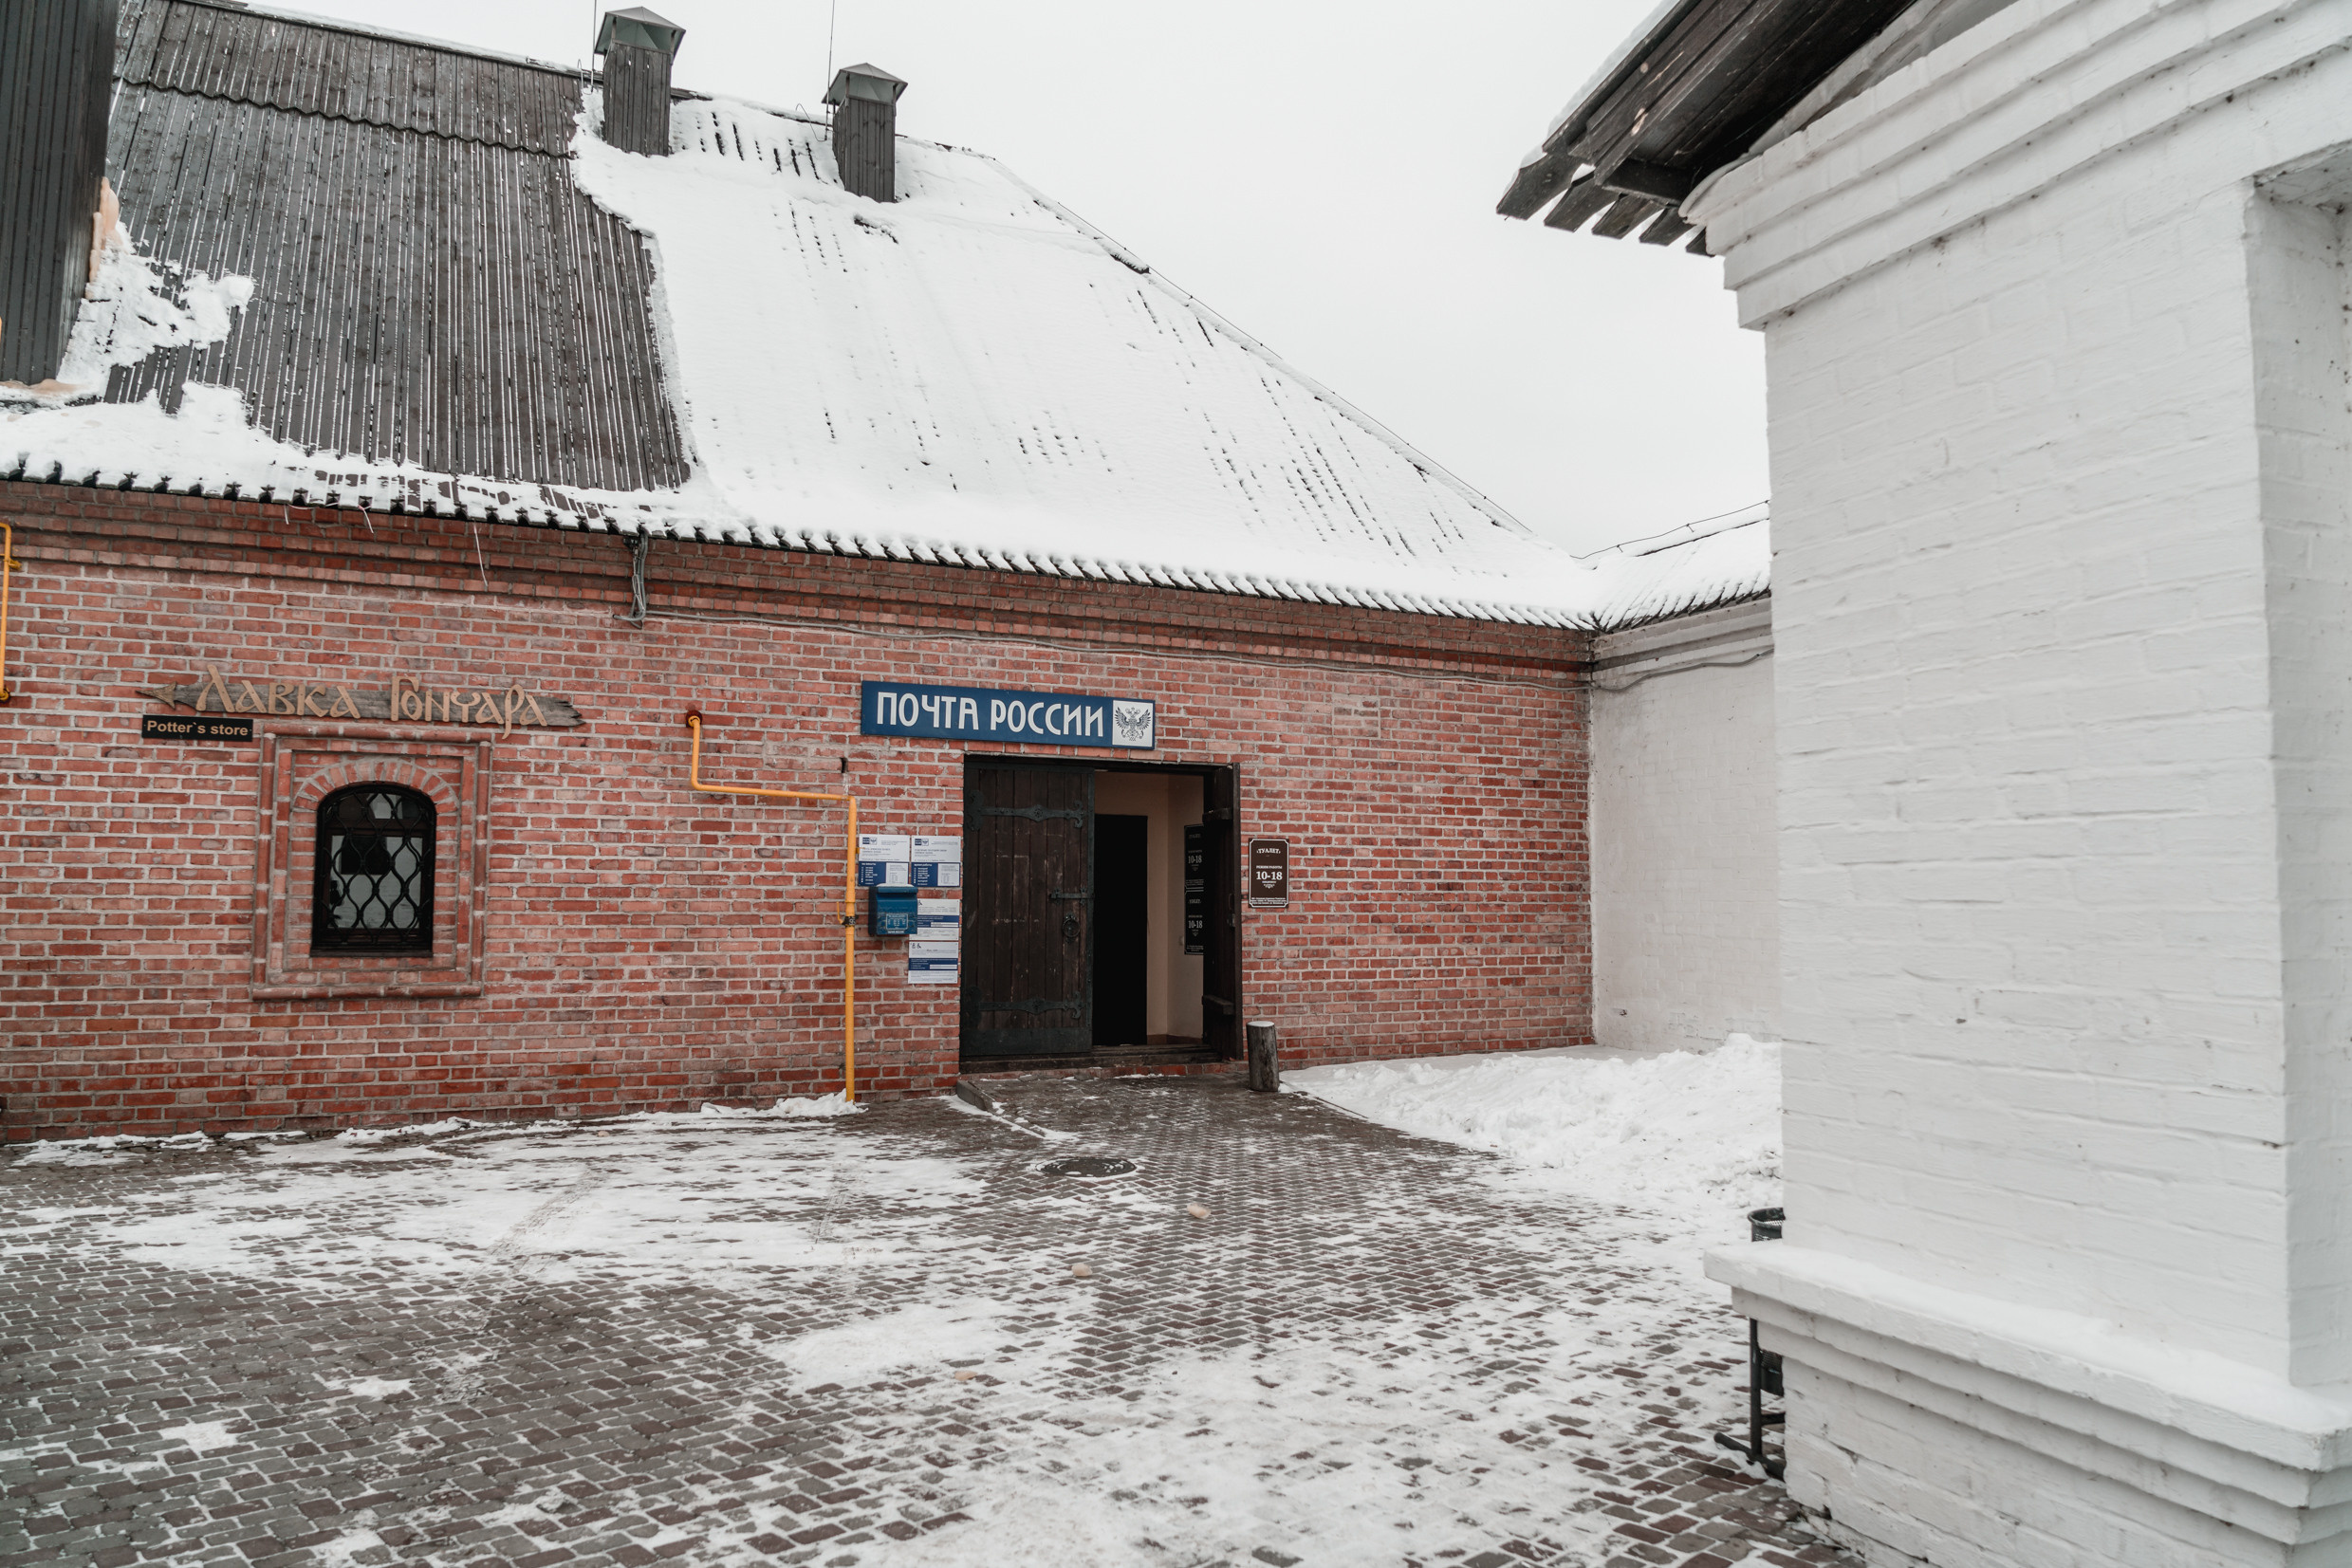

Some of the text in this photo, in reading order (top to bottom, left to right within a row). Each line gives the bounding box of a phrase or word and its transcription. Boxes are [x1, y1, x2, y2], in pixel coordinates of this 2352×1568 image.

[877, 692, 1104, 737] ПОЧТА РОССИИ
[210, 724, 249, 736] store
[1188, 855, 1202, 864] 10-18
[1256, 871, 1283, 880] 10-18
[1188, 920, 1203, 929] 10-18
